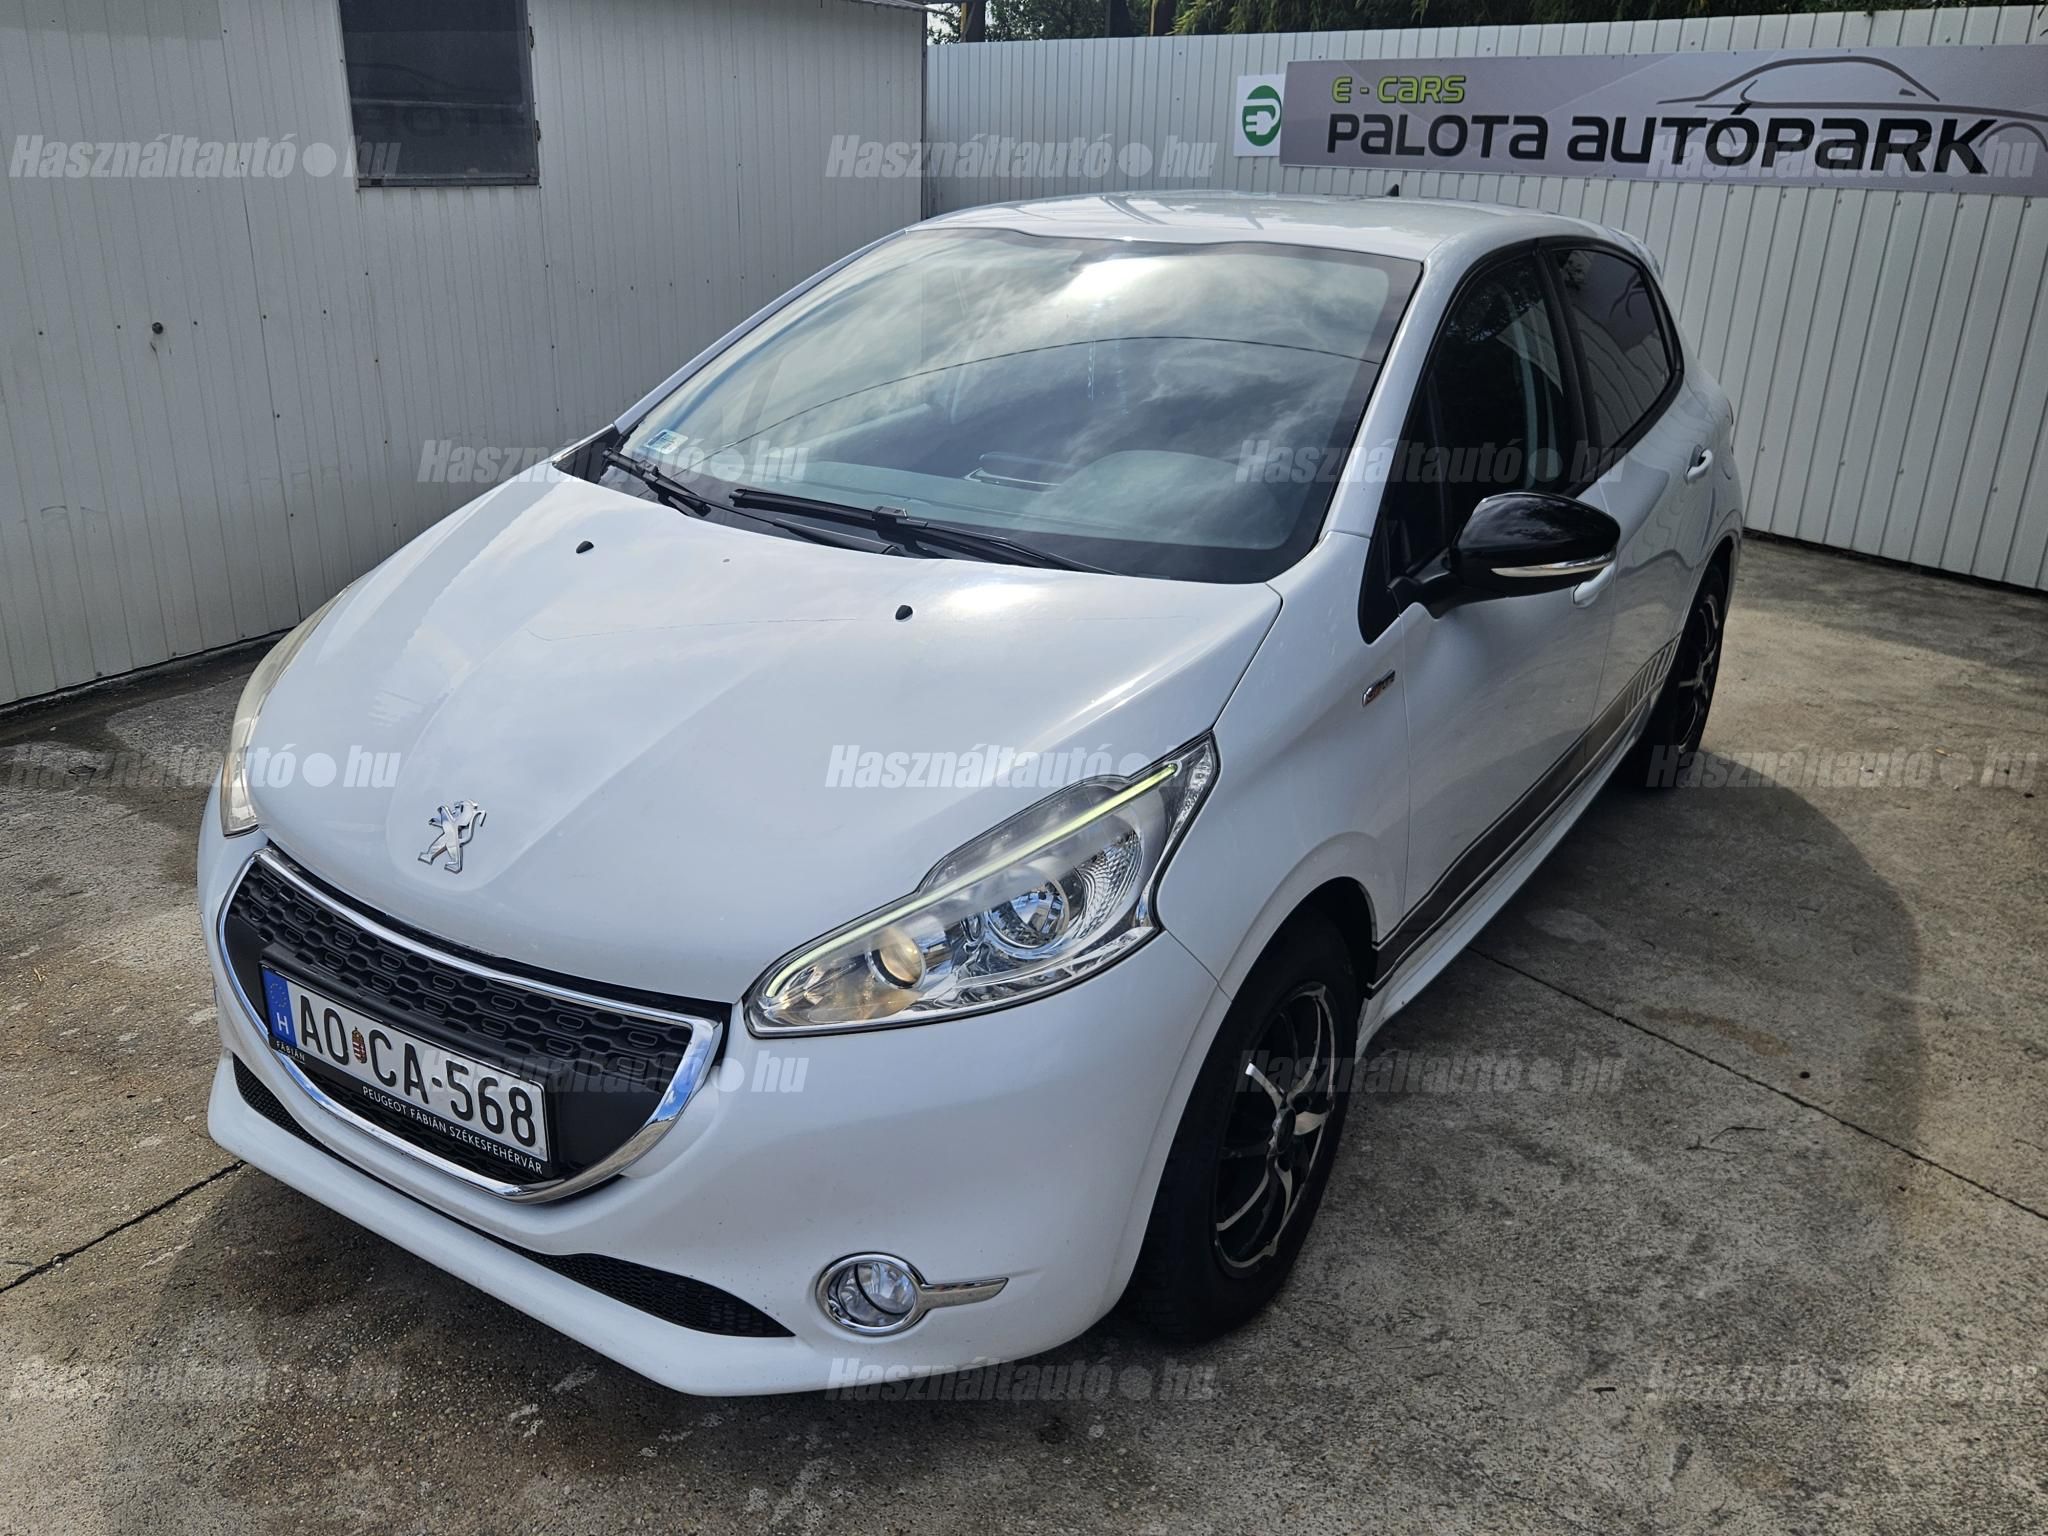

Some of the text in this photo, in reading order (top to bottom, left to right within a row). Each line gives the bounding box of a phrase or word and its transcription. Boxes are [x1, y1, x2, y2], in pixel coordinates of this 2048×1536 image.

[276, 1012, 290, 1037] H
[362, 1085, 543, 1175] PEUGEOT FÁBIÁN SZÉKESFEHÉRVÁR
[368, 1029, 537, 1148] CA-568
